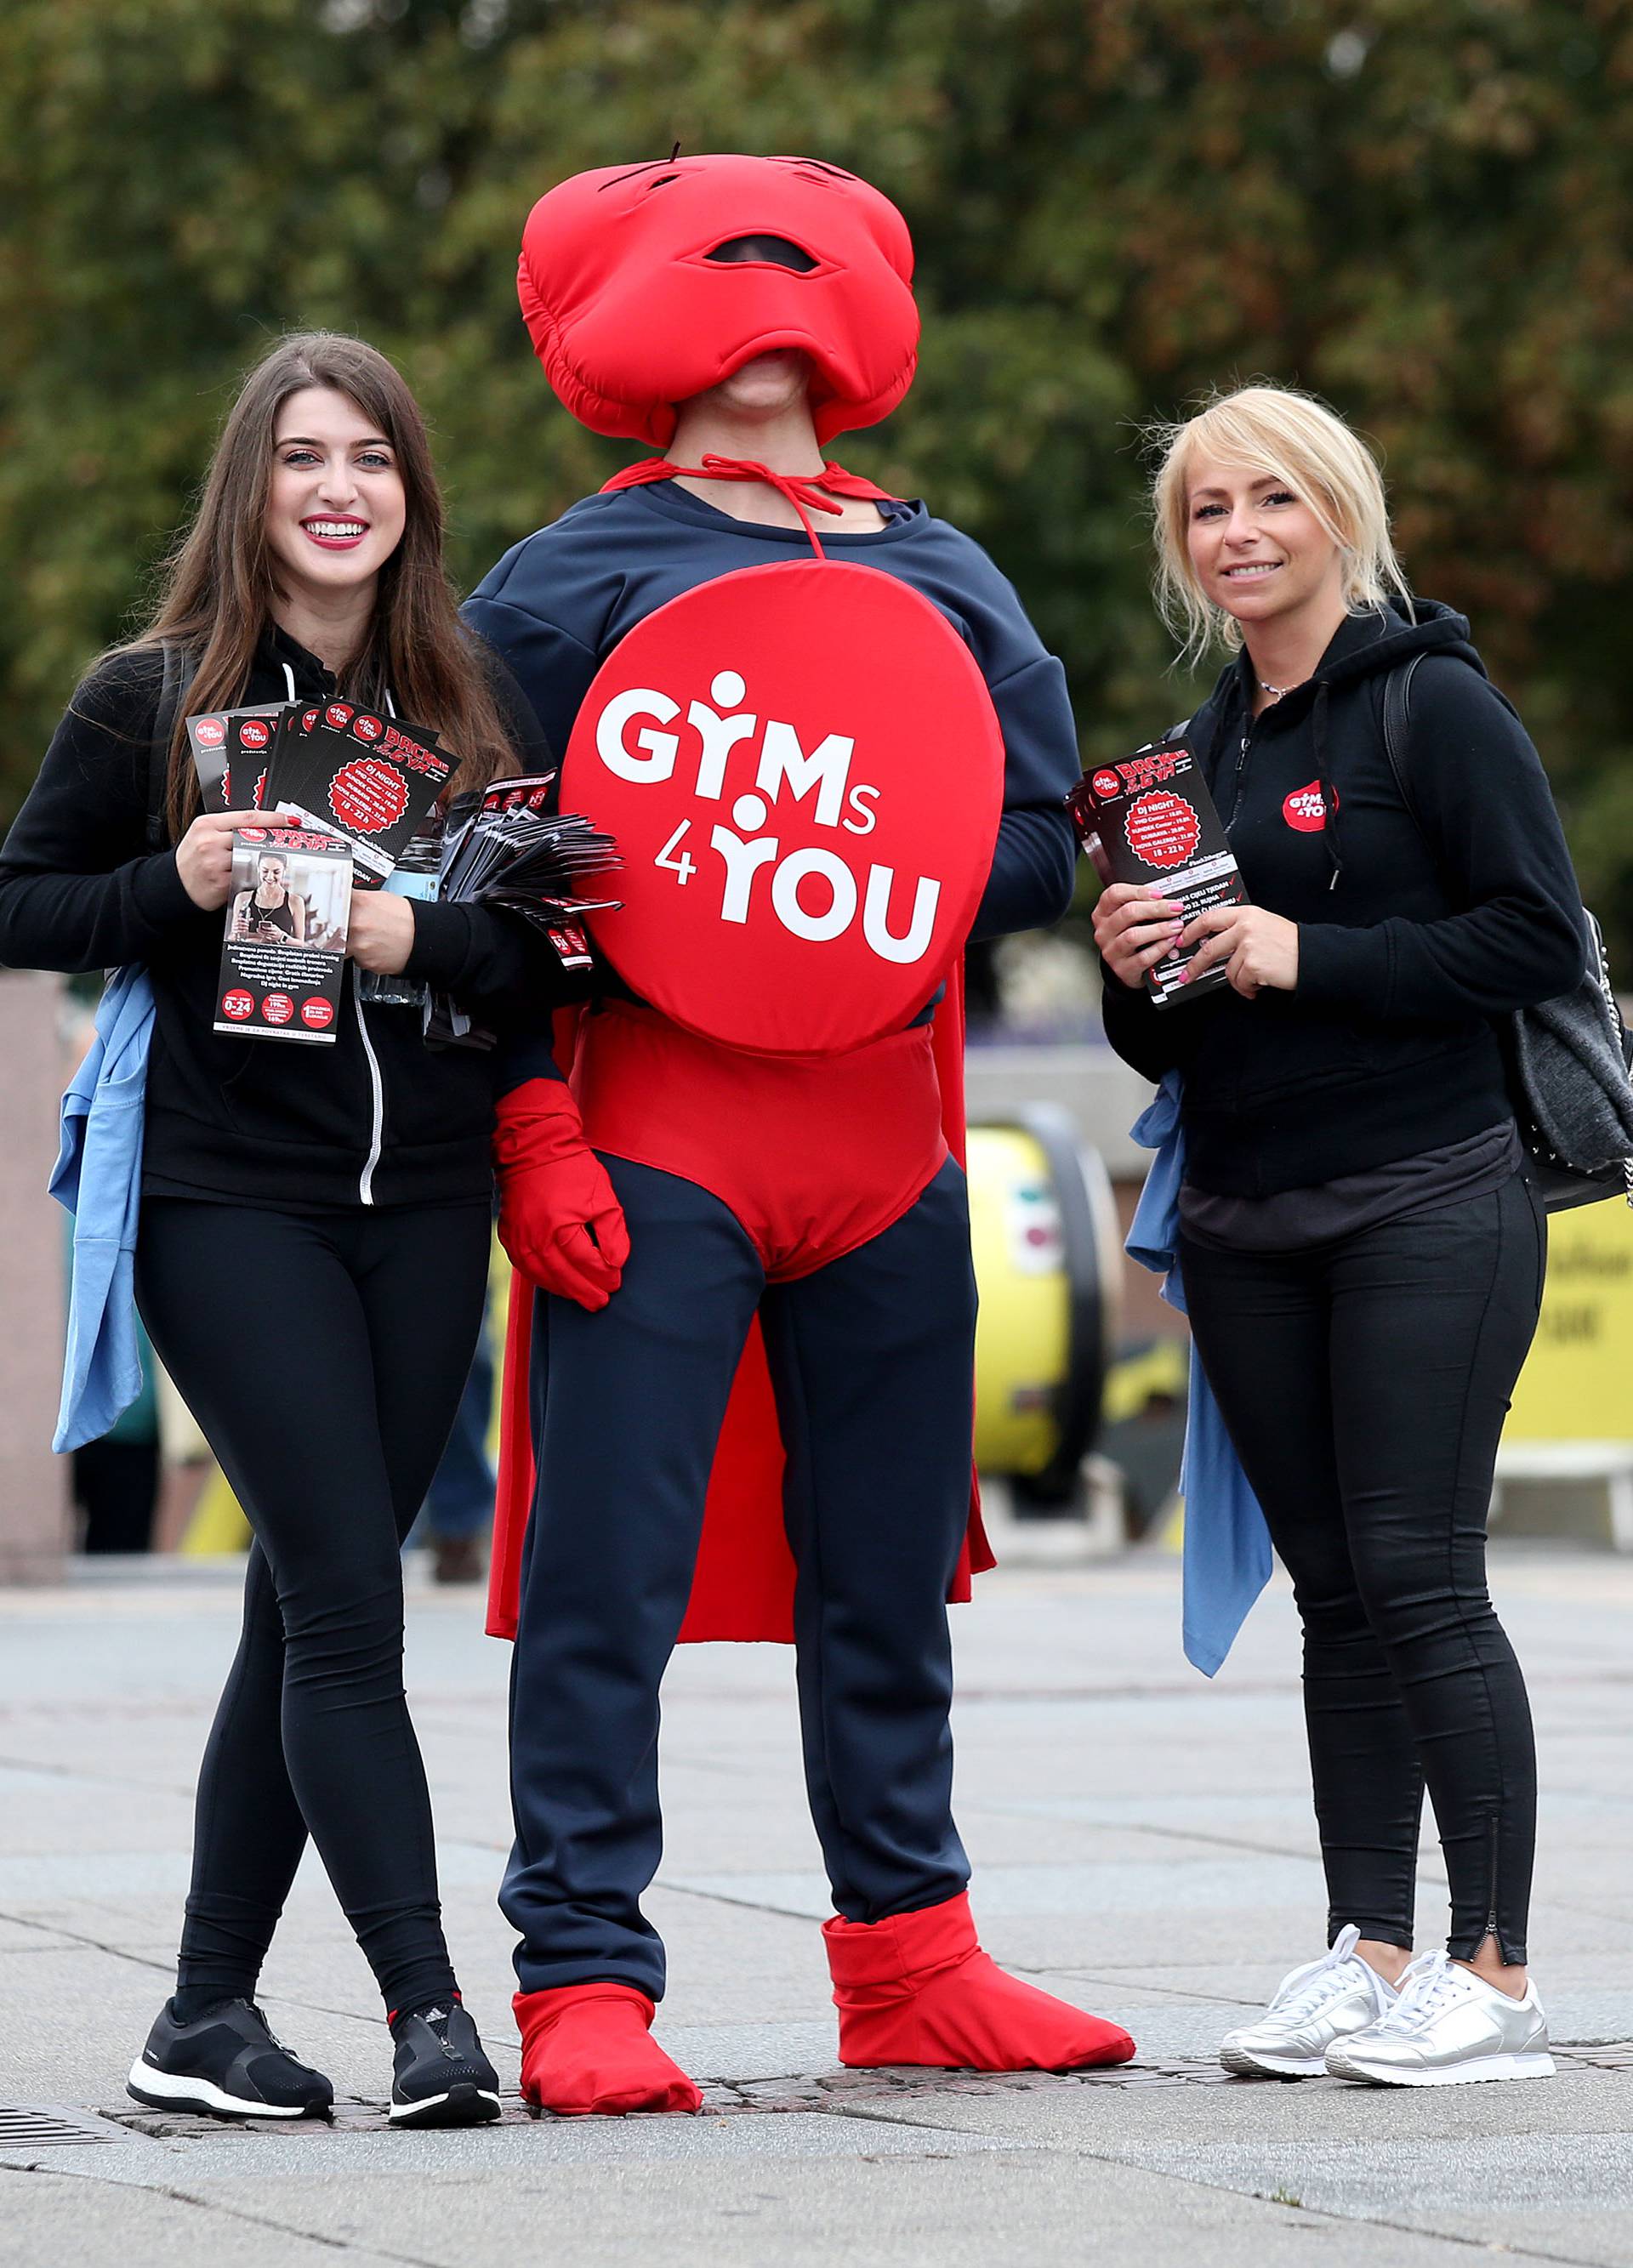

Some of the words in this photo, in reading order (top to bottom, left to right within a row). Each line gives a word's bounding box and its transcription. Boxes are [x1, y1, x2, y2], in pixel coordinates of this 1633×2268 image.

[384, 725, 433, 765] BACK
[389, 748, 430, 774] GYM
[1114, 754, 1171, 780] BACK
[366, 764, 377, 775] DJ
[375, 770, 401, 790] NIGHT
[1140, 762, 1175, 789] GYM
[334, 783, 350, 797] NOVA
[341, 800, 351, 810] 18
[353, 810, 364, 820] 22
[1137, 806, 1147, 815] DJ
[1147, 800, 1175, 812] NIGHT
[1296, 803, 1326, 817] 4YO
[1152, 849, 1163, 857] 18
[1167, 845, 1178, 854] 22
[1206, 881, 1229, 894] TJEDAN
[1201, 895, 1220, 906] RUJNA
[225, 1000, 251, 1012] 0-24
[303, 1004, 310, 1018] 1
